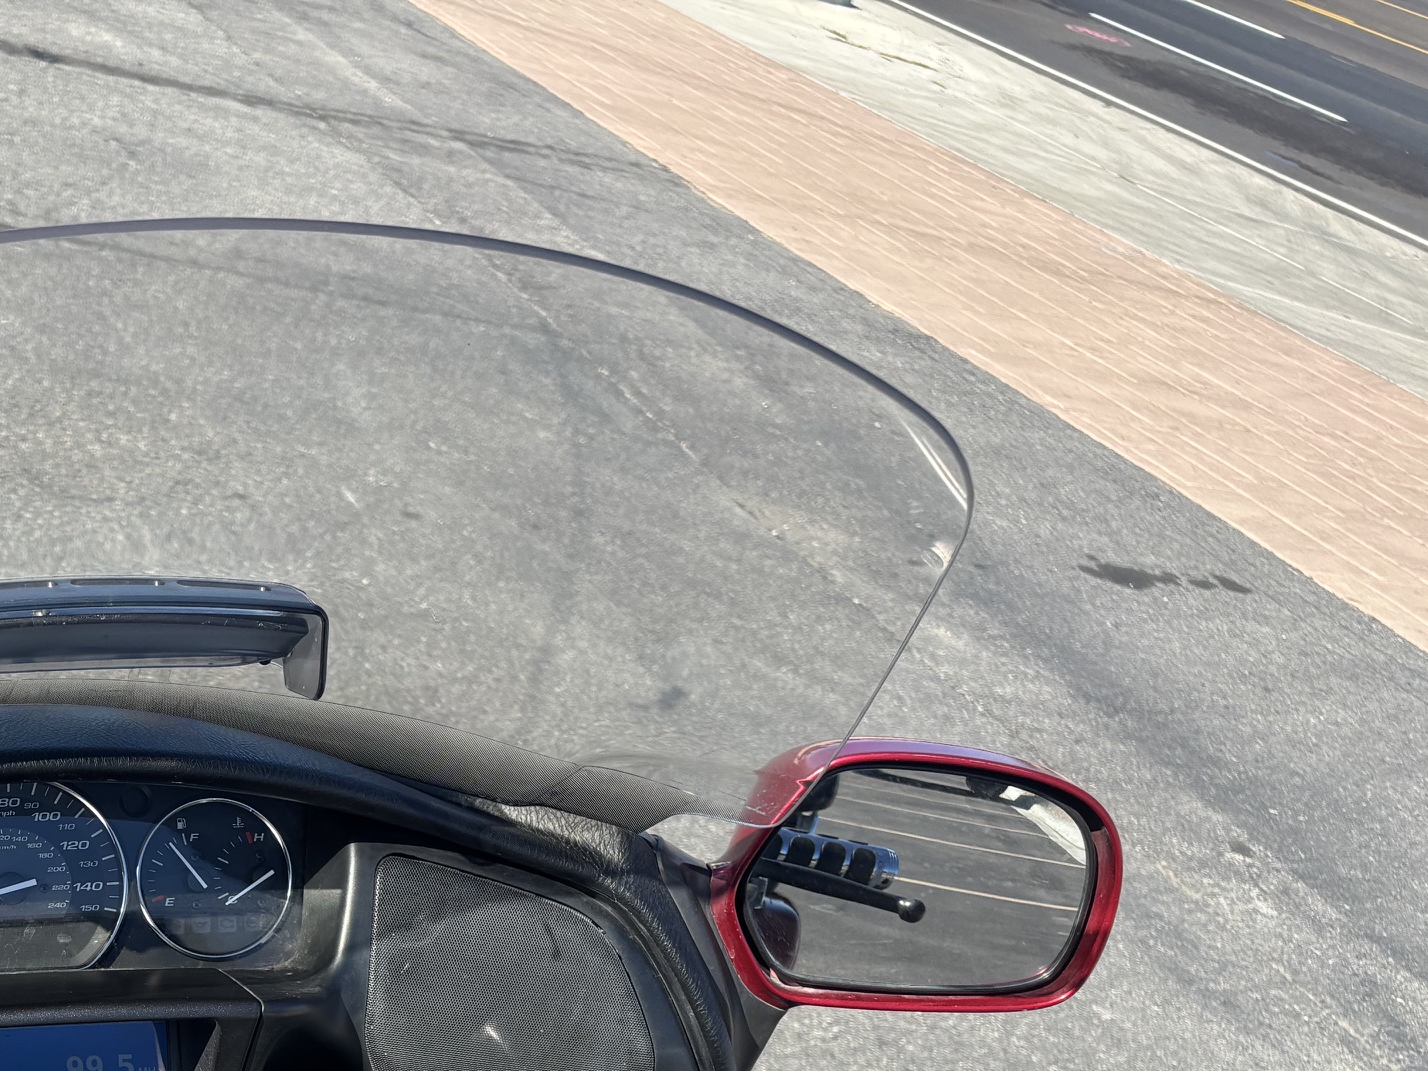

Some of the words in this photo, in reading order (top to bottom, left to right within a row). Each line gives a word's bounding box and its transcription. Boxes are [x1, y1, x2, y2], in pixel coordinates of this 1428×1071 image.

[32, 812, 61, 821] 100
[190, 833, 199, 841] F
[254, 833, 264, 841] H
[60, 841, 89, 850] 120
[73, 882, 103, 891] 140
[165, 898, 175, 906] E
